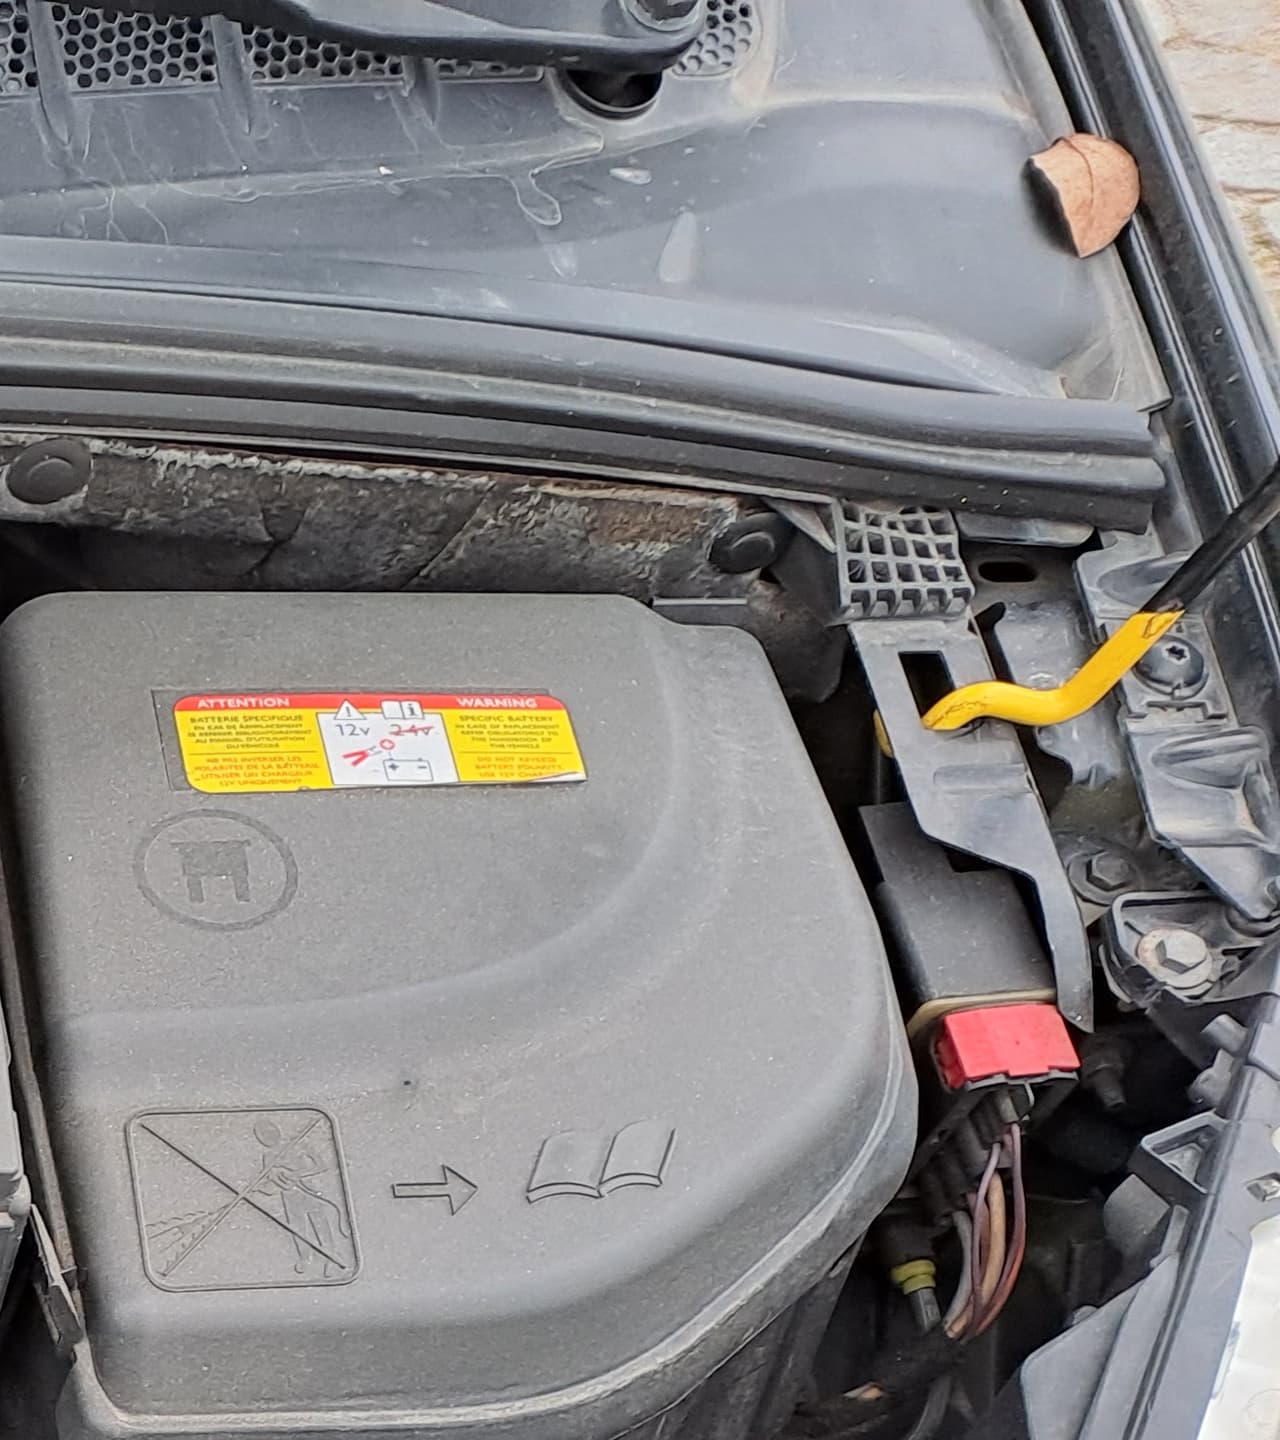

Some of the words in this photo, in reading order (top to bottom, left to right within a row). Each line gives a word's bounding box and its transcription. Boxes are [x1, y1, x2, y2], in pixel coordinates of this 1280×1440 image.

[198, 697, 290, 708] ATTENTION
[457, 698, 538, 708] WARNING
[335, 723, 370, 736] 12v
